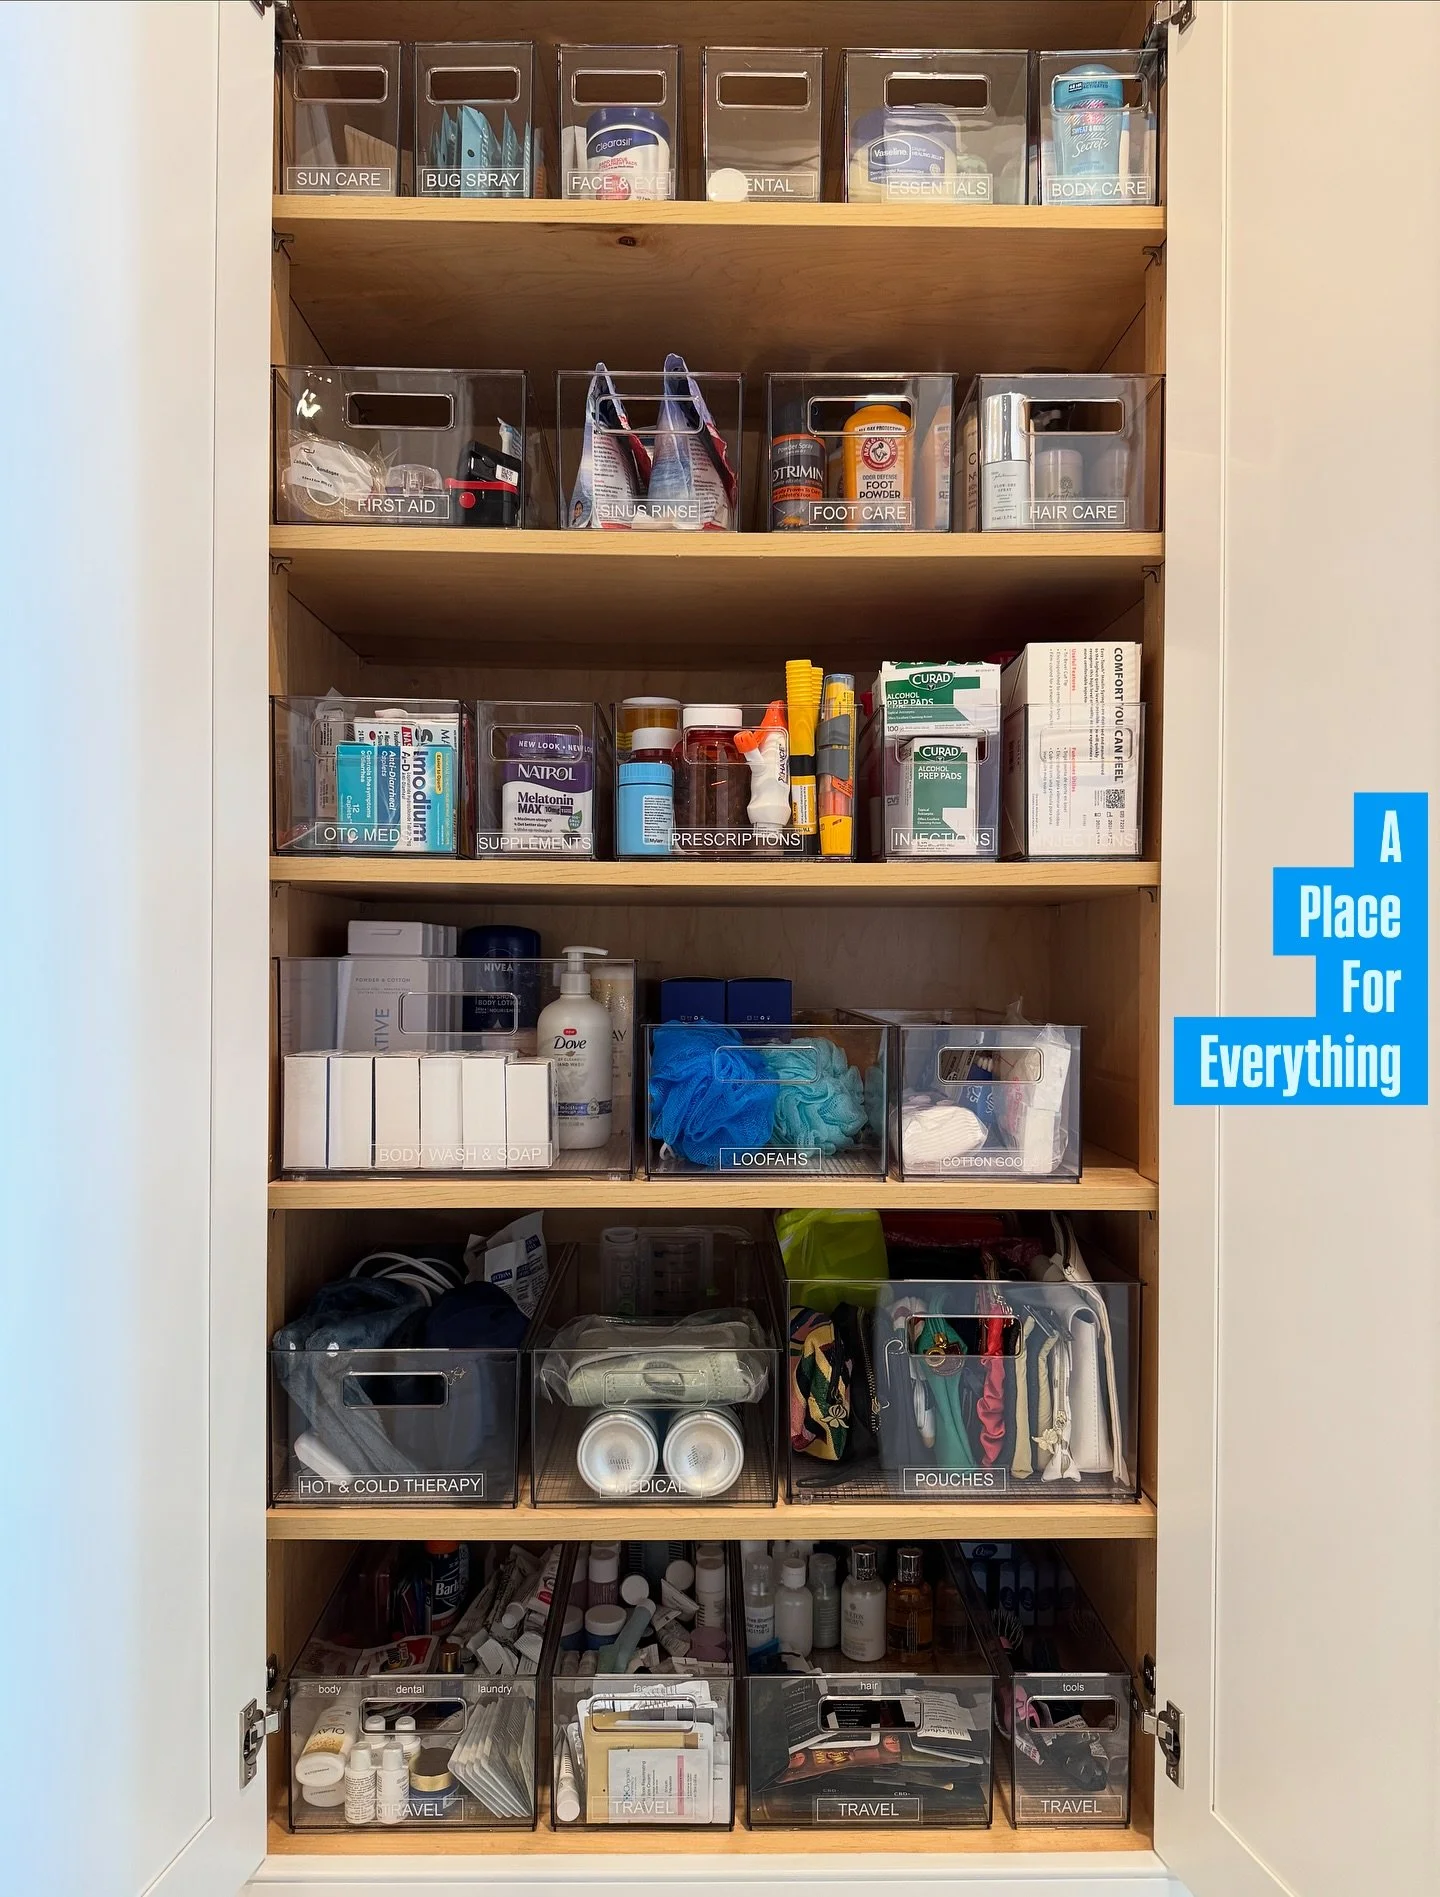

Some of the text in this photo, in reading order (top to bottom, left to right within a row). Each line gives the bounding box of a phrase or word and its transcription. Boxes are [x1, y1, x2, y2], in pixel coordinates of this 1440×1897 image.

[595, 137, 632, 154] Clearasil
[874, 147, 908, 157] Vaseline
[1072, 137, 1107, 158] Secret
[296, 171, 382, 187] SUN CARE
[426, 172, 520, 188] BUG SPRAY
[572, 176, 667, 190] FACE & EYE
[740, 178, 794, 193] ENTAL
[889, 181, 987, 195] ESSENTIALS
[1052, 181, 1147, 197] BODY CARE
[866, 481, 894, 489] FOOT
[859, 490, 901, 499] POWDER
[357, 499, 436, 513] FIRST AID
[600, 504, 698, 519] SINUS RINSE
[813, 505, 907, 520] FOOT CARE
[1029, 505, 1068, 520] HAIR
[1072, 505, 1118, 519] CARE
[912, 673, 951, 685] CURAD
[1114, 648, 1124, 701] COMFORT
[887, 691, 920, 700] ALCOHOL
[887, 699, 909, 709] PREP
[518, 740, 582, 752] NEW LOOK NEW
[1114, 729, 1124, 754] CAN
[922, 746, 959, 757] CURAD
[401, 751, 411, 772] A-D
[518, 763, 576, 781] NATROL
[918, 772, 962, 780] PREP PADS
[1114, 756, 1124, 782] FEEL
[388, 750, 397, 811] Anti-Diarrheal
[413, 750, 431, 842] Imodium
[517, 791, 574, 806] Melatonin
[352, 803, 360, 813] 12
[518, 803, 542, 814] MAX
[324, 828, 359, 842] OTC
[671, 832, 801, 846] PRESCRIPTIONS
[478, 836, 592, 850] SUPPLEMENTS
[484, 963, 513, 972] NIVEA
[553, 1035, 587, 1050] Dove
[380, 1147, 542, 1162] BODY WASH & SOAP
[732, 1152, 808, 1166] LOOFAHS
[942, 1156, 993, 1167] COTTON
[300, 1478, 481, 1494] HOT & COLD THERAPY
[915, 1472, 994, 1487] POUCHES
[318, 1684, 512, 1696] body dental laundry
[860, 1681, 878, 1690] hair
[1062, 1682, 1085, 1692] tools
[314, 1727, 345, 1736] OLAY
[612, 1800, 675, 1814] TRAVEL
[838, 1803, 899, 1817] TRAVEL
[1040, 1800, 1102, 1814] TRAVEL
